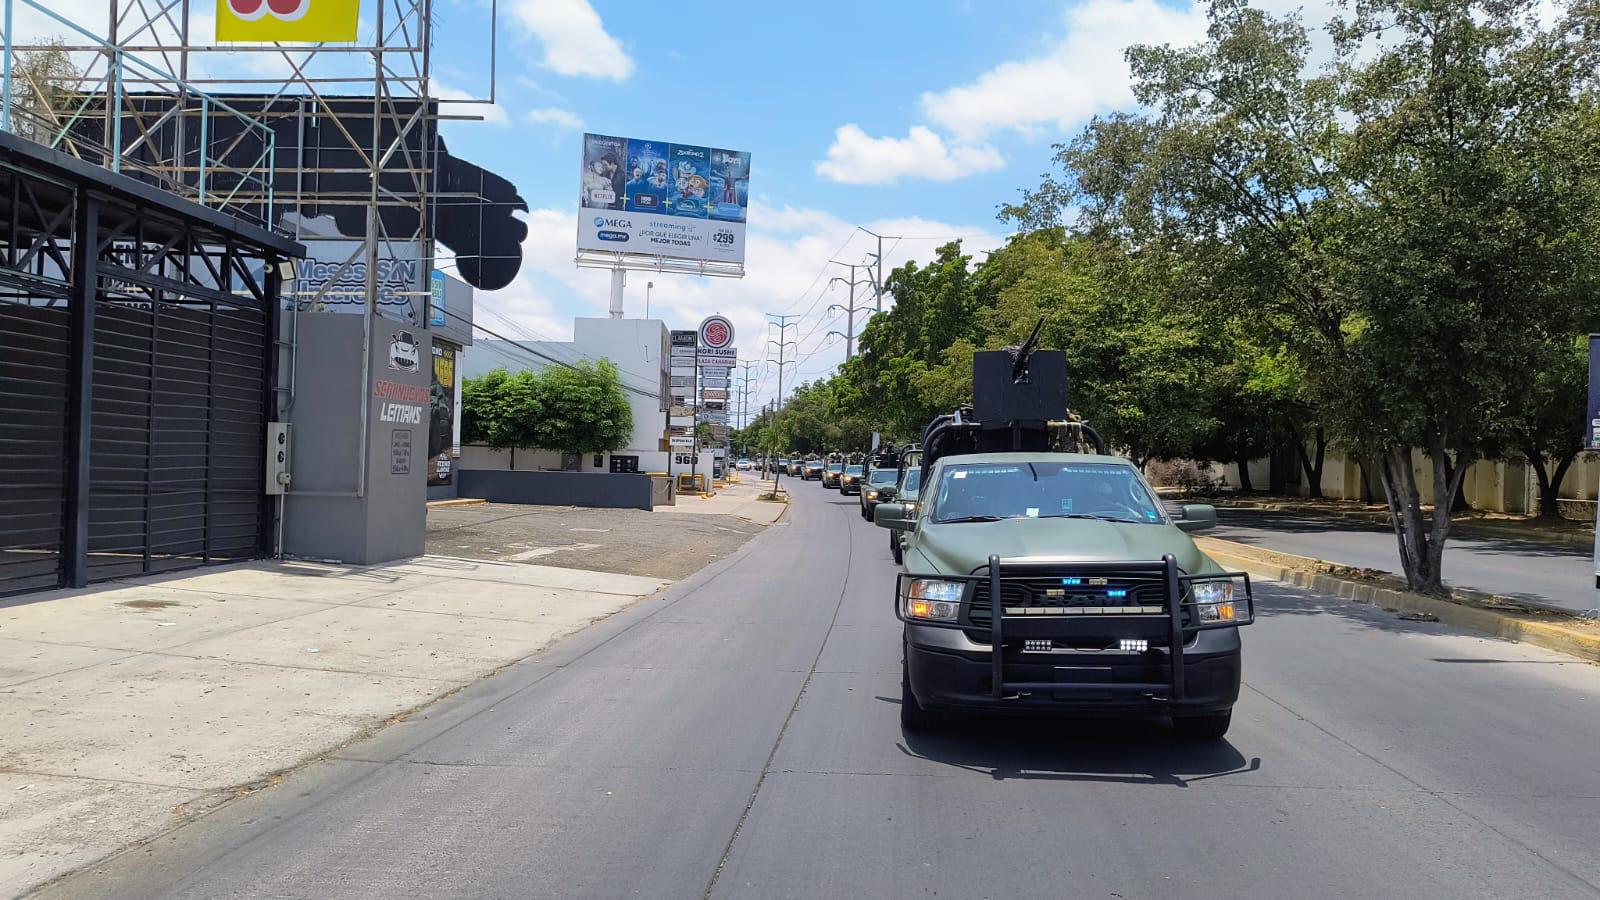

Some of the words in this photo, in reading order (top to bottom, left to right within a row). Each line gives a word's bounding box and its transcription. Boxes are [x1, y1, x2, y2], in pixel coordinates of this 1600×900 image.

[605, 218, 633, 229] MEGA
[650, 221, 686, 231] streaming
[671, 239, 692, 247] TODAS
[713, 232, 735, 244] $299
[380, 402, 422, 424] LEMANS
